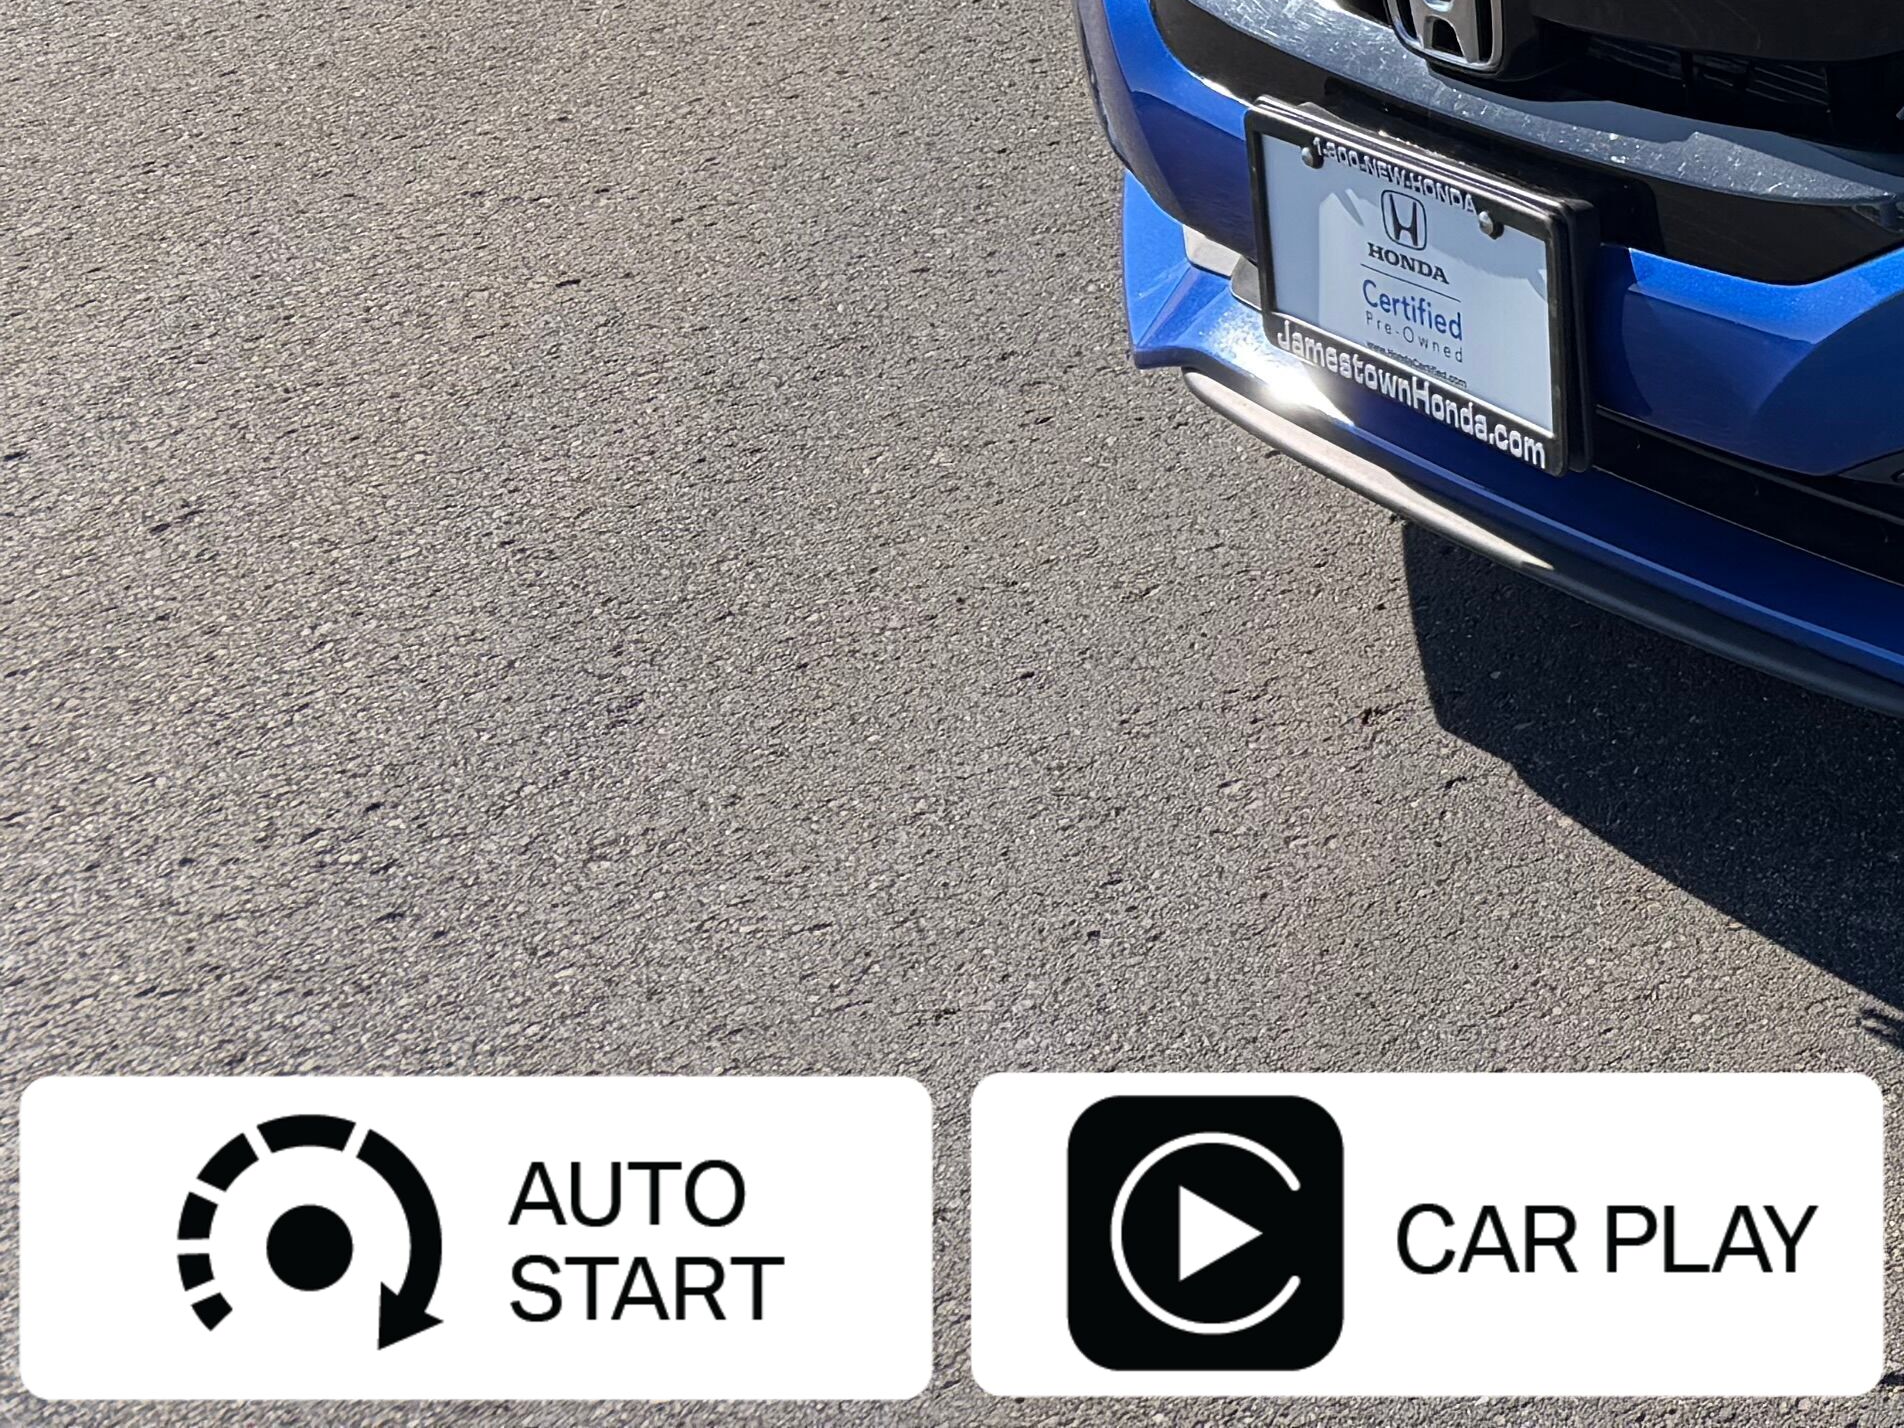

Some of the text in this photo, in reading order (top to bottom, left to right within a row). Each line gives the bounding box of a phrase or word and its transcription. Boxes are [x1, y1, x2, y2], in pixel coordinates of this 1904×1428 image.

[1367, 242, 1450, 285] HONDA
[1362, 279, 1463, 341] Certified
[1365, 310, 1464, 364] Pre-Owned
[1276, 319, 1547, 469] JamestownHonda.com
